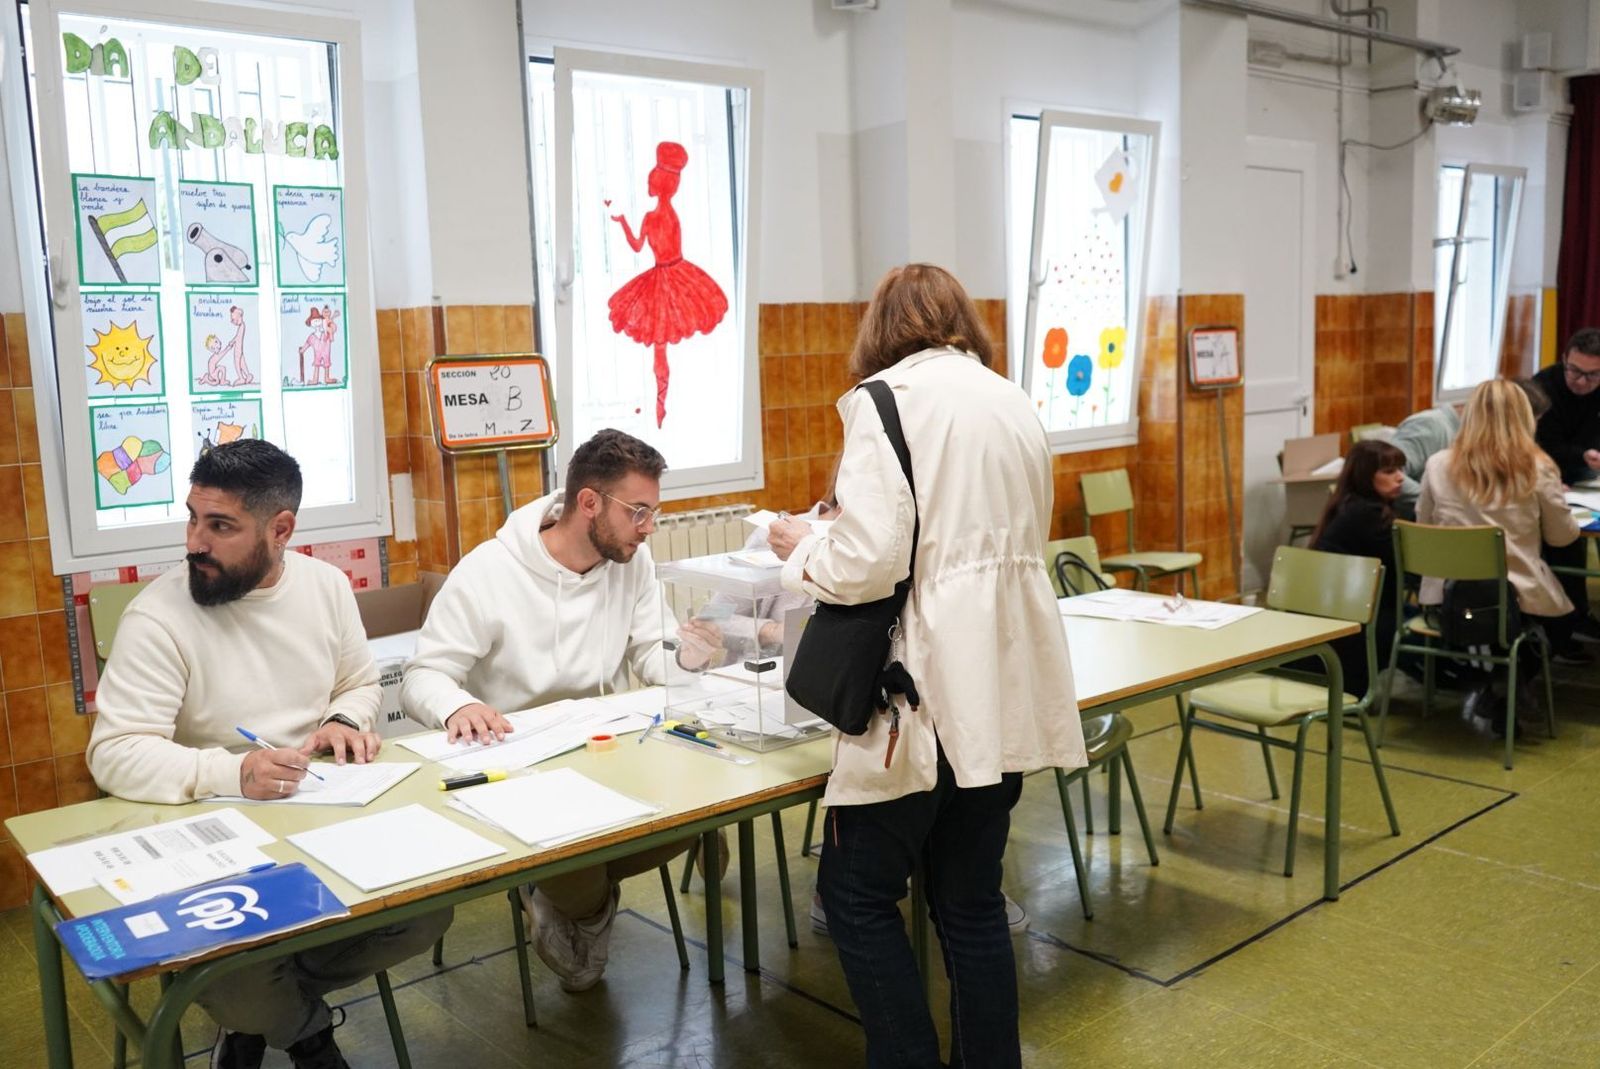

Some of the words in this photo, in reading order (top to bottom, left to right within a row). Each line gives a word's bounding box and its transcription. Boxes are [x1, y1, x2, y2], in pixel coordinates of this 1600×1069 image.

[174, 45, 221, 86] DE
[444, 393, 489, 407] MESA
[506, 386, 523, 411] B
[485, 421, 496, 436] M
[520, 419, 535, 432] Z
